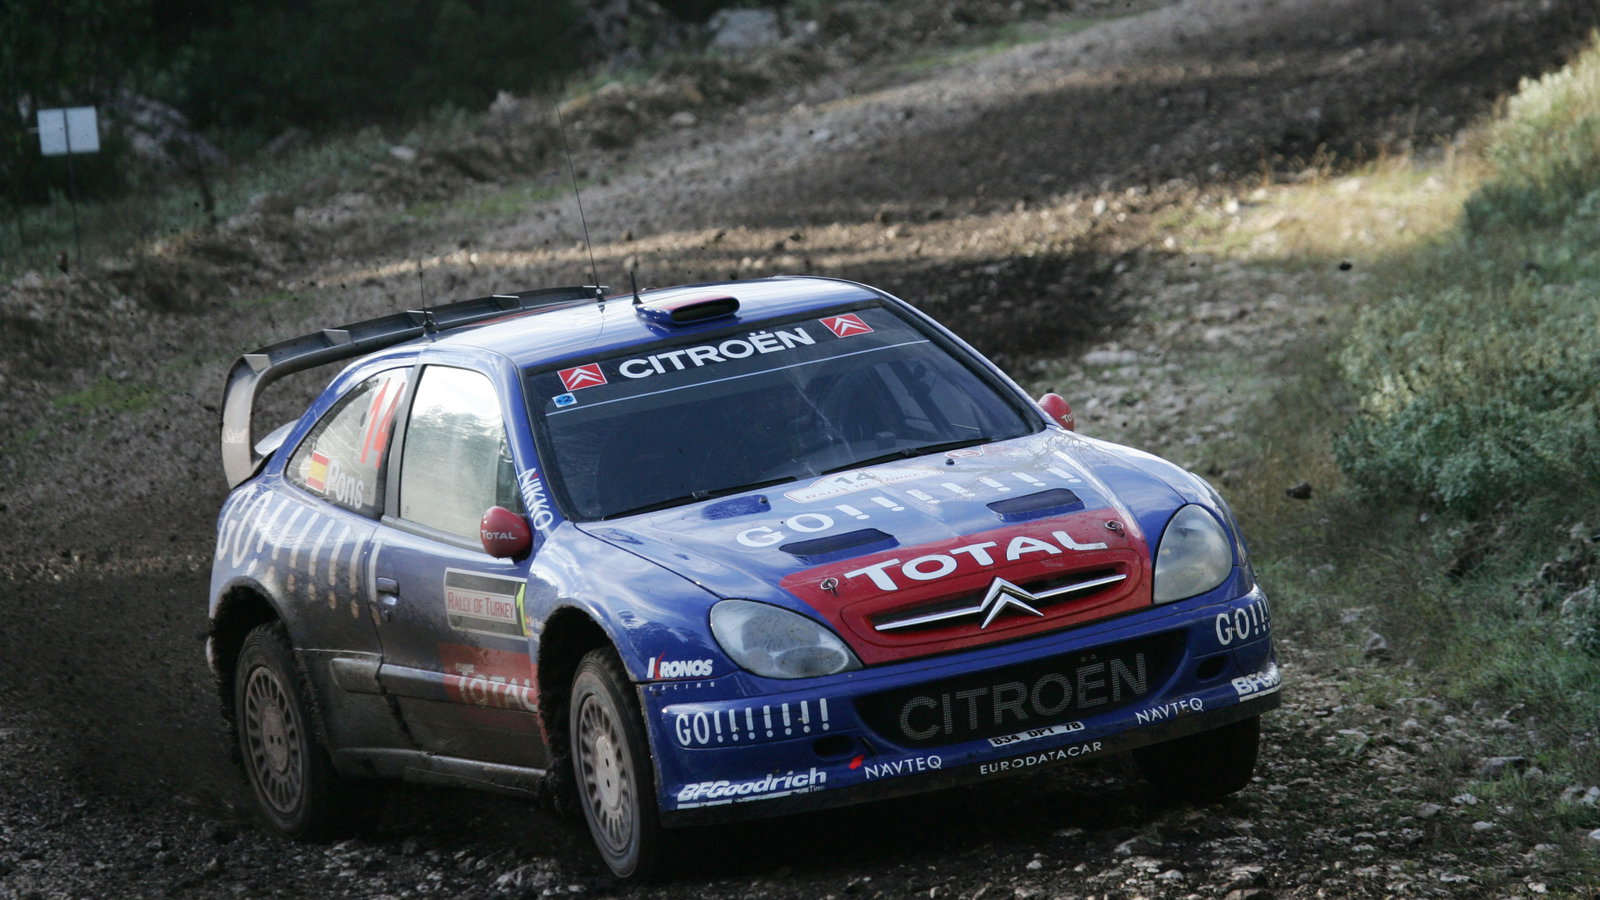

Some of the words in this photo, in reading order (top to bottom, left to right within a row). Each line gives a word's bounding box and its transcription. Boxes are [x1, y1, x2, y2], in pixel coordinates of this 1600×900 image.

[619, 327, 816, 379] CITROËN
[360, 377, 406, 469] 14
[324, 458, 364, 510] Pons
[834, 470, 878, 486] 14
[518, 468, 553, 530] NIKKO
[736, 467, 1082, 547] GO!!!!!!!
[480, 529, 517, 540] TOTAL
[845, 530, 1108, 592] TOTAL
[447, 591, 472, 613] RALLY
[473, 597, 483, 614] OF
[485, 597, 515, 619] TURKEY
[646, 650, 713, 680] KRONOS
[455, 662, 539, 712] TOTAL
[648, 681, 716, 692] RACING
[899, 652, 1149, 740] CITROËN
[675, 697, 829, 746] GO!!!!!!!
[1062, 722, 1081, 732] 78
[1135, 697, 1204, 725] NAVTEQ
[864, 755, 942, 779] NAVTEQ
[979, 741, 1103, 775] EURODATACAR
[677, 767, 827, 802] BFGoodrich
